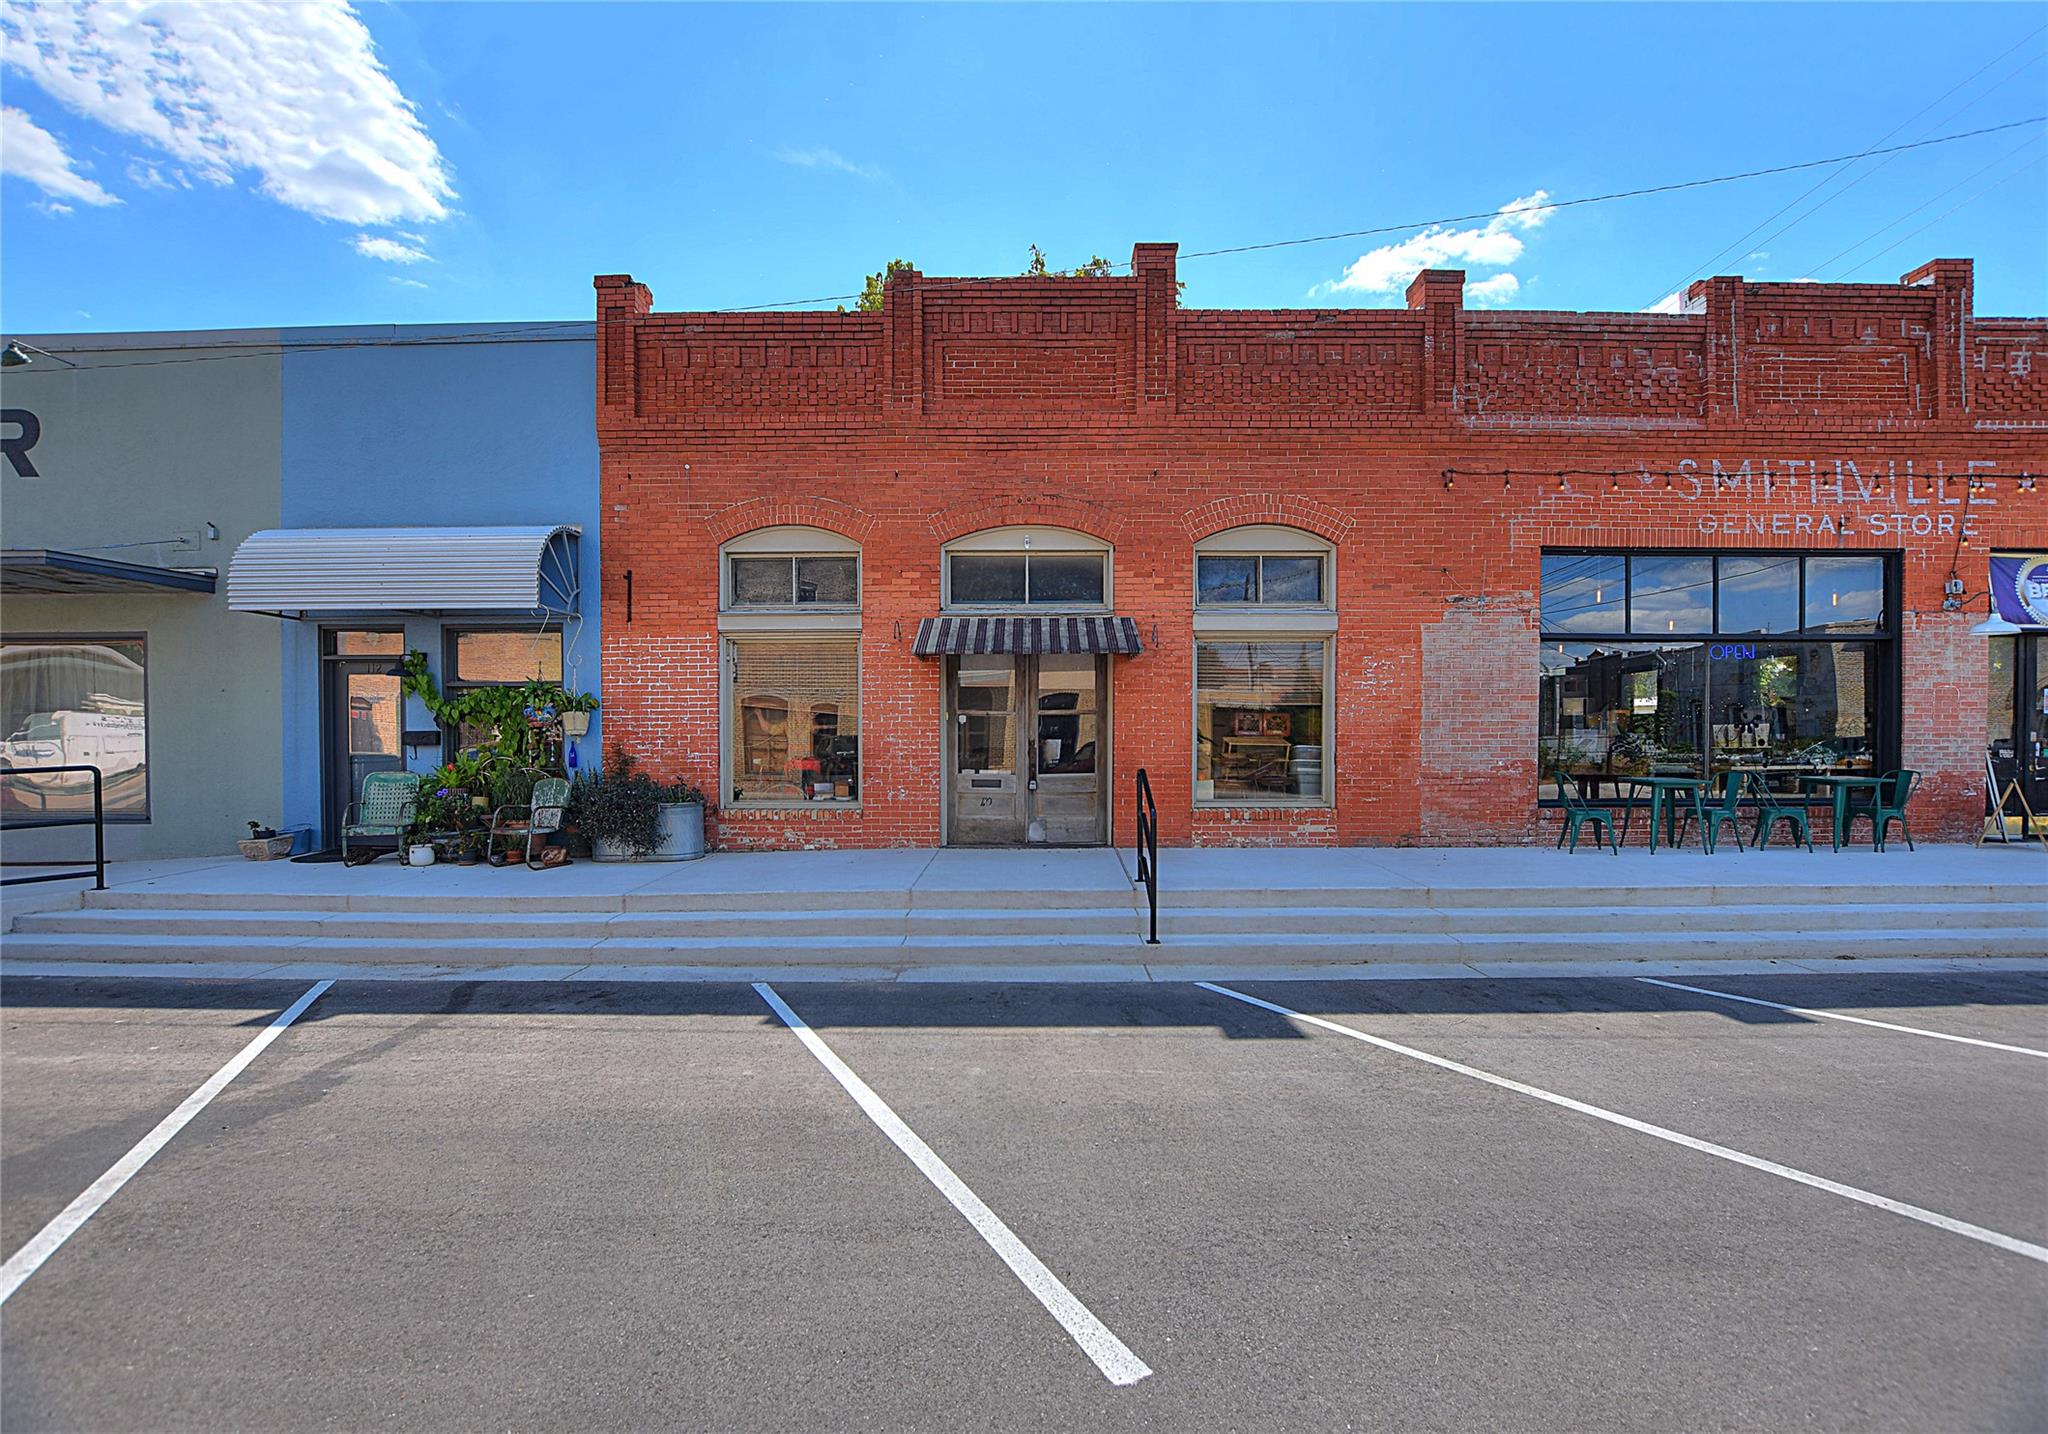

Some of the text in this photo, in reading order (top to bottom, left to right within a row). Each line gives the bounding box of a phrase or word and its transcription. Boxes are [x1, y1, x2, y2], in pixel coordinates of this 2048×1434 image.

[1678, 458, 1997, 505] SMITHVILLE
[1698, 513, 1979, 537] GENERAL STORE
[1709, 642, 1756, 660] OPEN
[367, 663, 384, 674] 112
